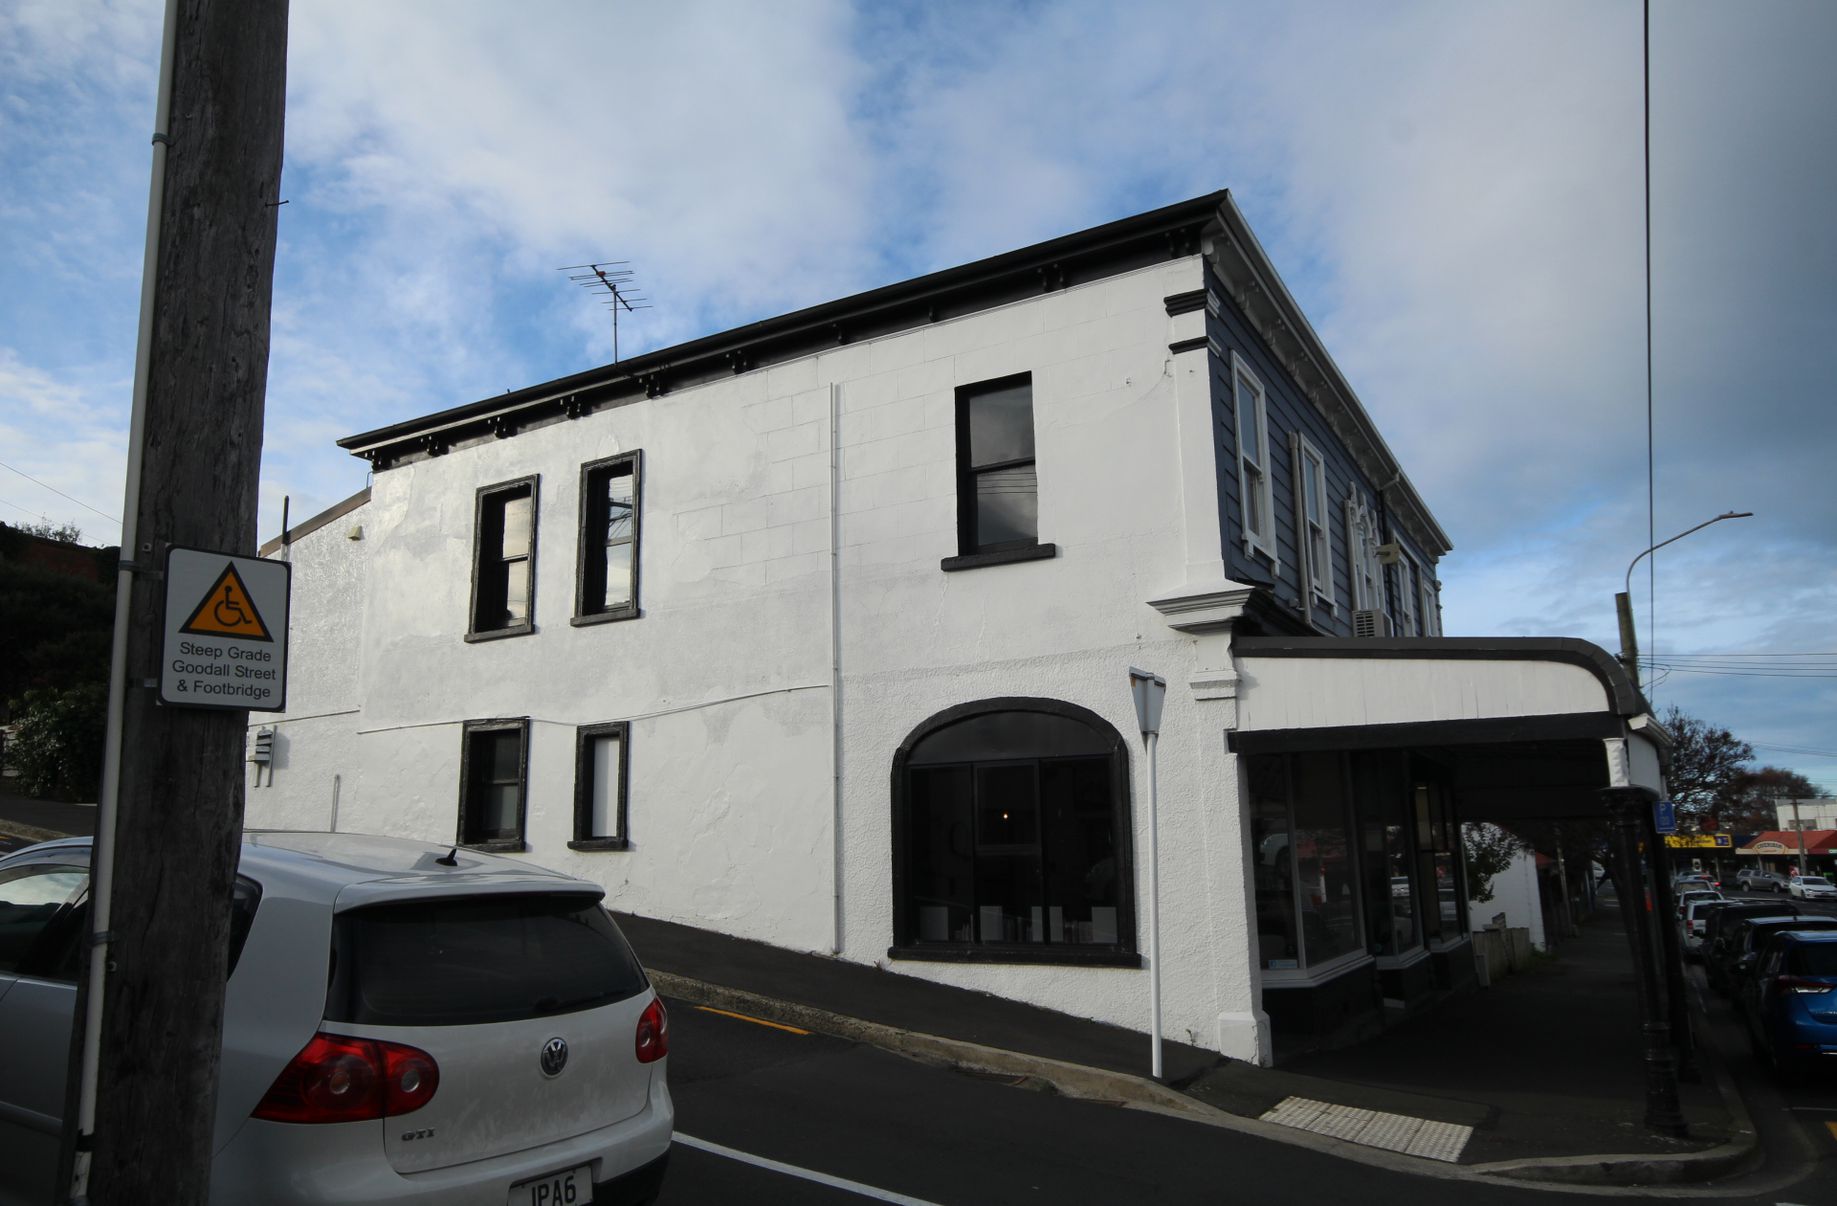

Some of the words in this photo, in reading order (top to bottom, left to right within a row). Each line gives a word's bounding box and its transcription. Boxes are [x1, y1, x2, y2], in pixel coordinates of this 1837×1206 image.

[180, 641, 222, 660] Steep
[227, 646, 271, 662] Grade
[172, 659, 230, 676] Goodall
[234, 665, 276, 680] Street
[176, 679, 188, 692] &
[193, 680, 271, 700] Footbridge
[401, 1127, 436, 1142] GTI
